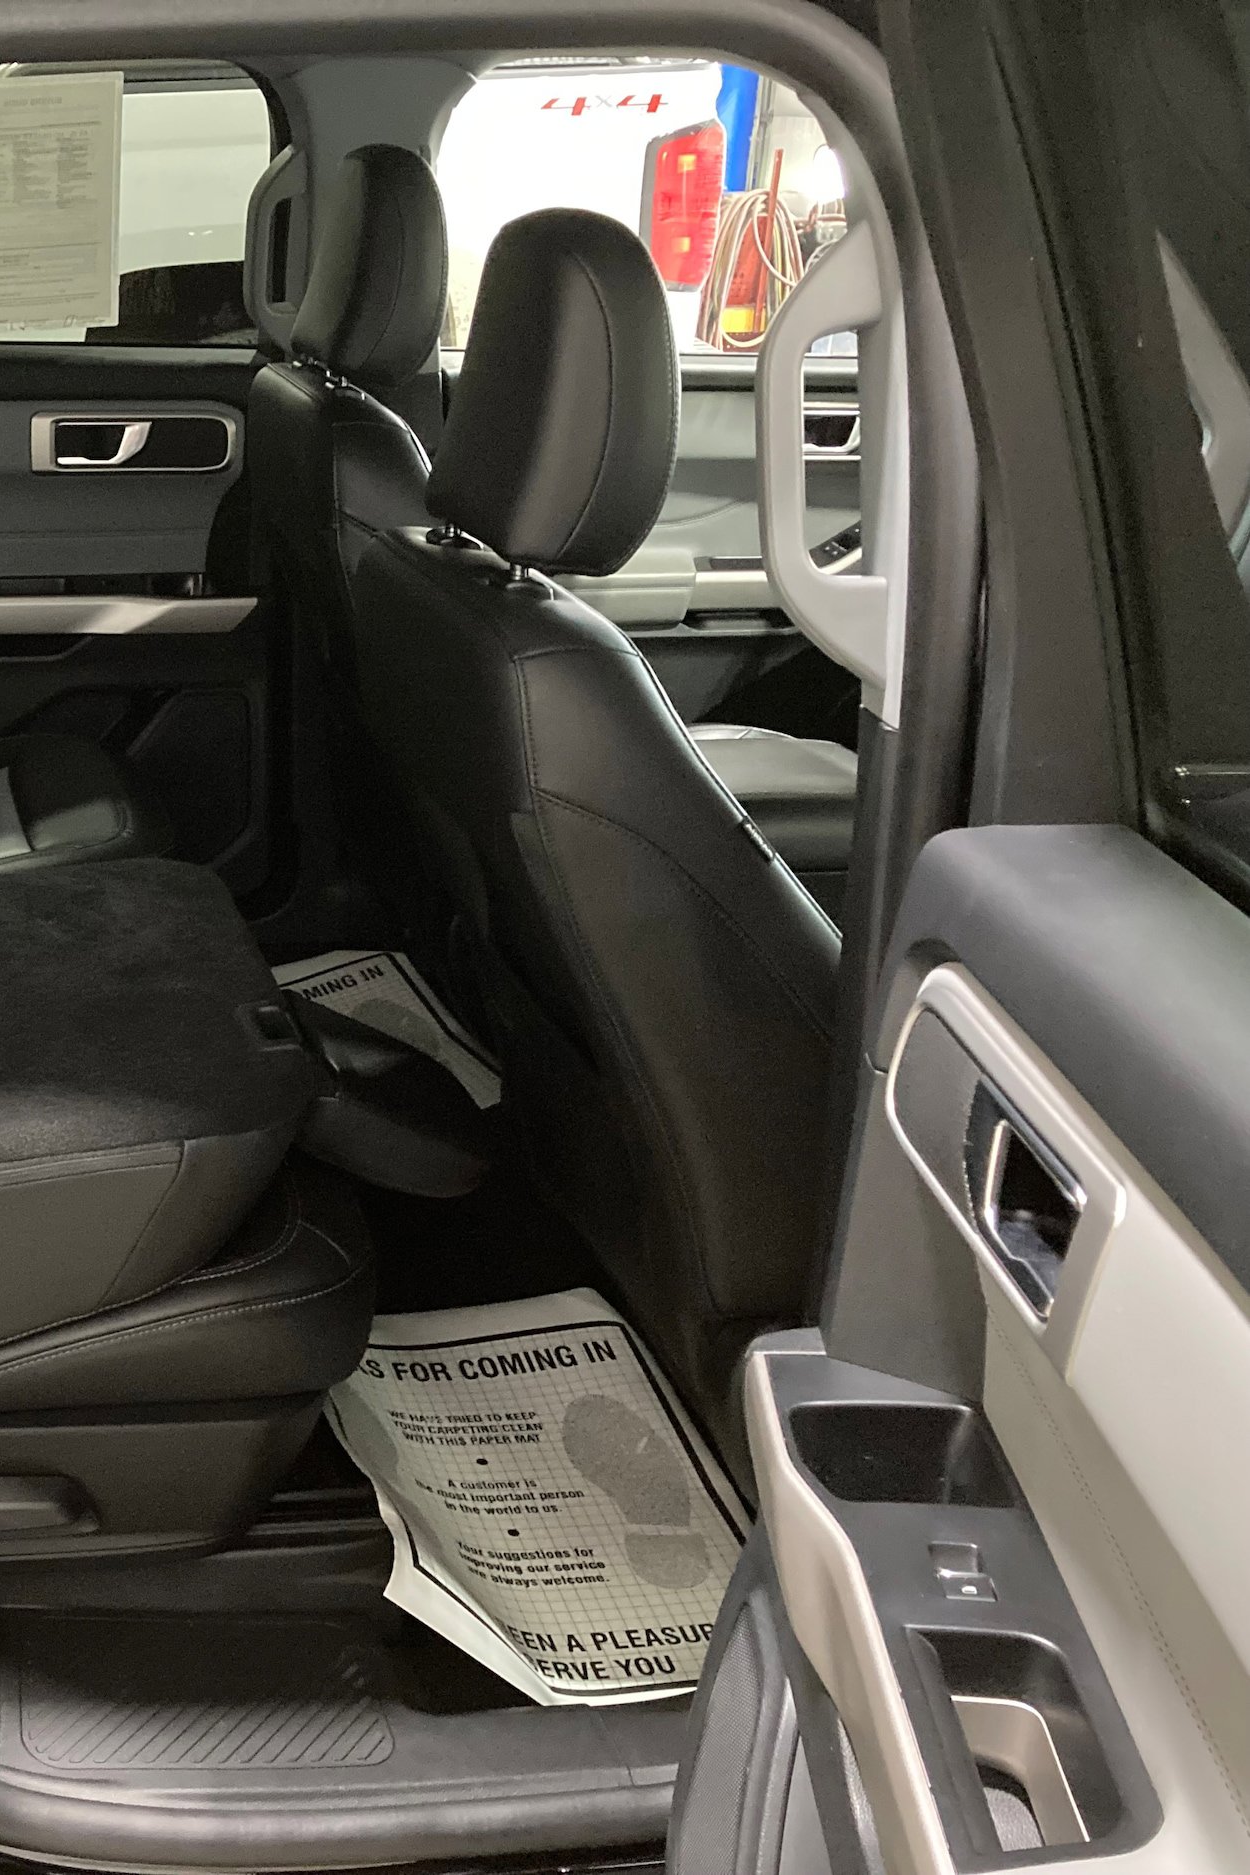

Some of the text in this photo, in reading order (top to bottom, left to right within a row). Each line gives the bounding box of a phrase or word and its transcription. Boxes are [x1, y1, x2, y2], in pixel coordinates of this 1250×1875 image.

[302, 965, 384, 1000] MING IN
[391, 1362, 452, 1382] FOR
[458, 1345, 578, 1380] COMING
[582, 1340, 617, 1363] IN
[388, 1410, 406, 1420] WE
[446, 1414, 483, 1424] TRIED
[485, 1413, 502, 1422] TO
[505, 1411, 536, 1421] KEEP
[393, 1420, 543, 1435] YOUR CARPETING CLEAN
[401, 1430, 541, 1447] WITH THIS PAPER MAT
[447, 1478, 538, 1490] A customer is
[436, 1488, 468, 1501] most
[471, 1492, 536, 1504] important
[539, 1489, 585, 1501] person
[444, 1500, 563, 1515] in the world to us.
[457, 1541, 595, 1562] Your suggestions for
[526, 1564, 550, 1573] our
[554, 1560, 606, 1572] service
[490, 1573, 538, 1589] always
[541, 1574, 610, 1586] welcome.
[506, 1623, 714, 1652] EEN A PLEASUR
[615, 1655, 676, 1677] YOU
